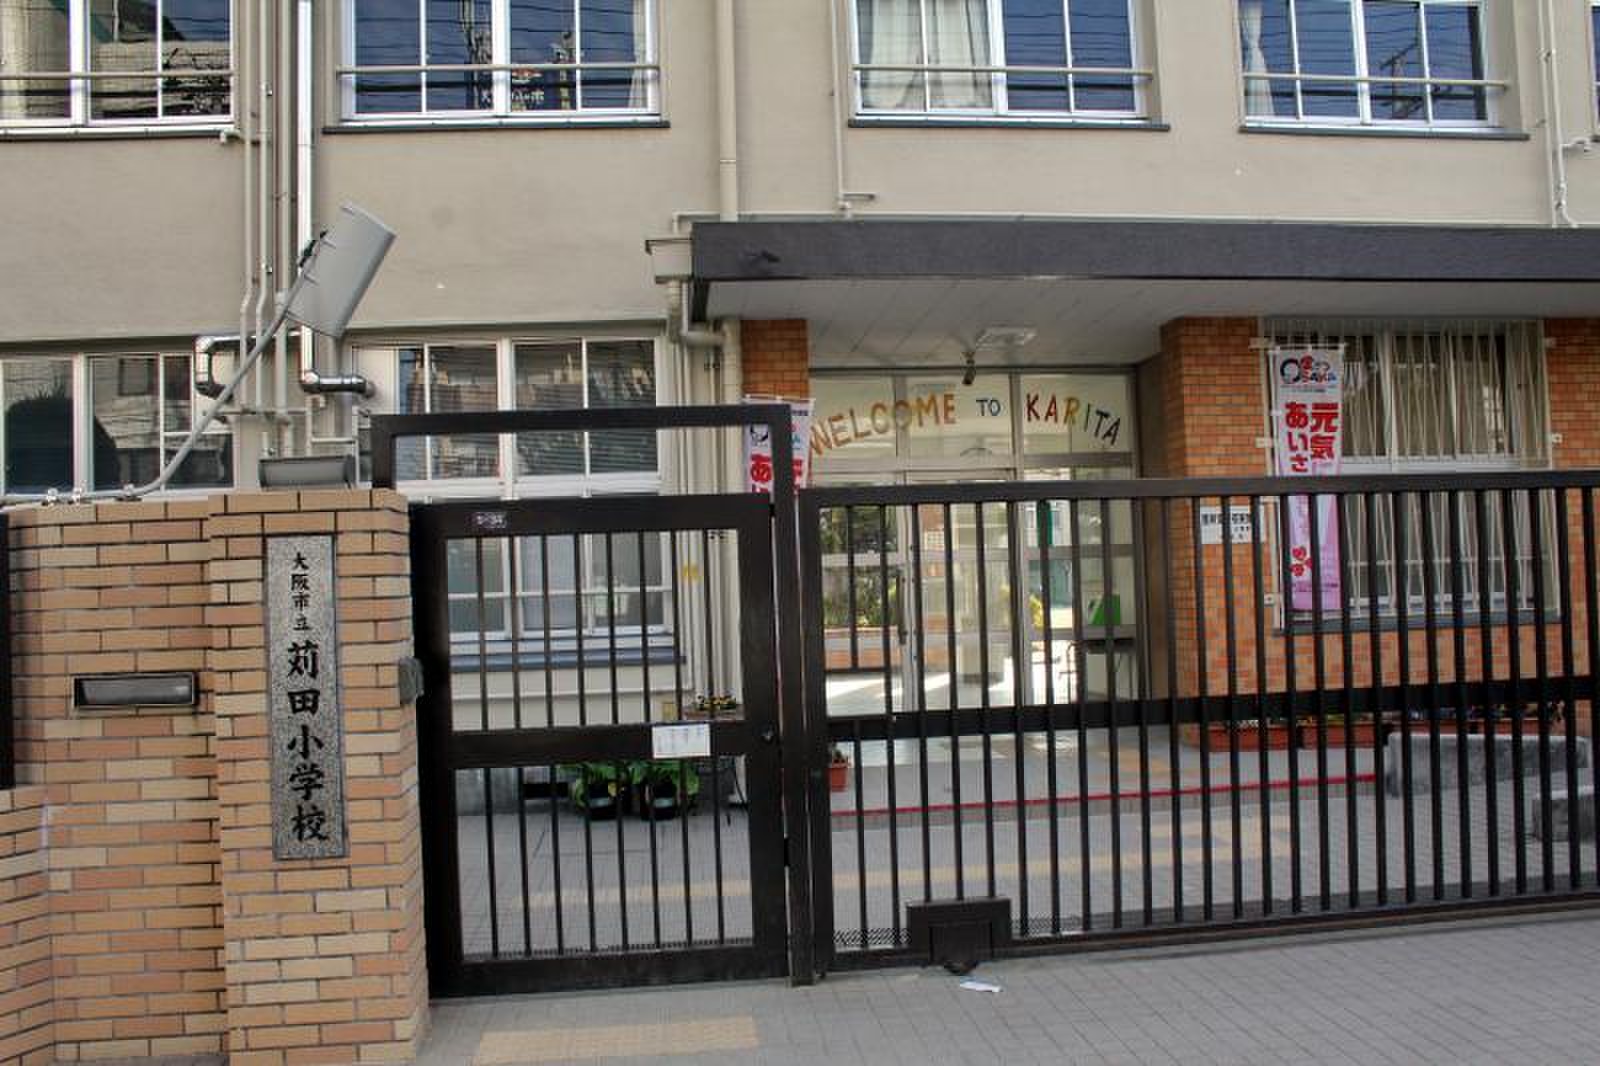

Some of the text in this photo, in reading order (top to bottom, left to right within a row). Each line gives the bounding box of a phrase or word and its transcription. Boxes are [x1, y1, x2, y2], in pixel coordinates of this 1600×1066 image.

[810, 392, 1120, 455] WELCOME TO KARITA
[1311, 402, 1338, 459] 元気
